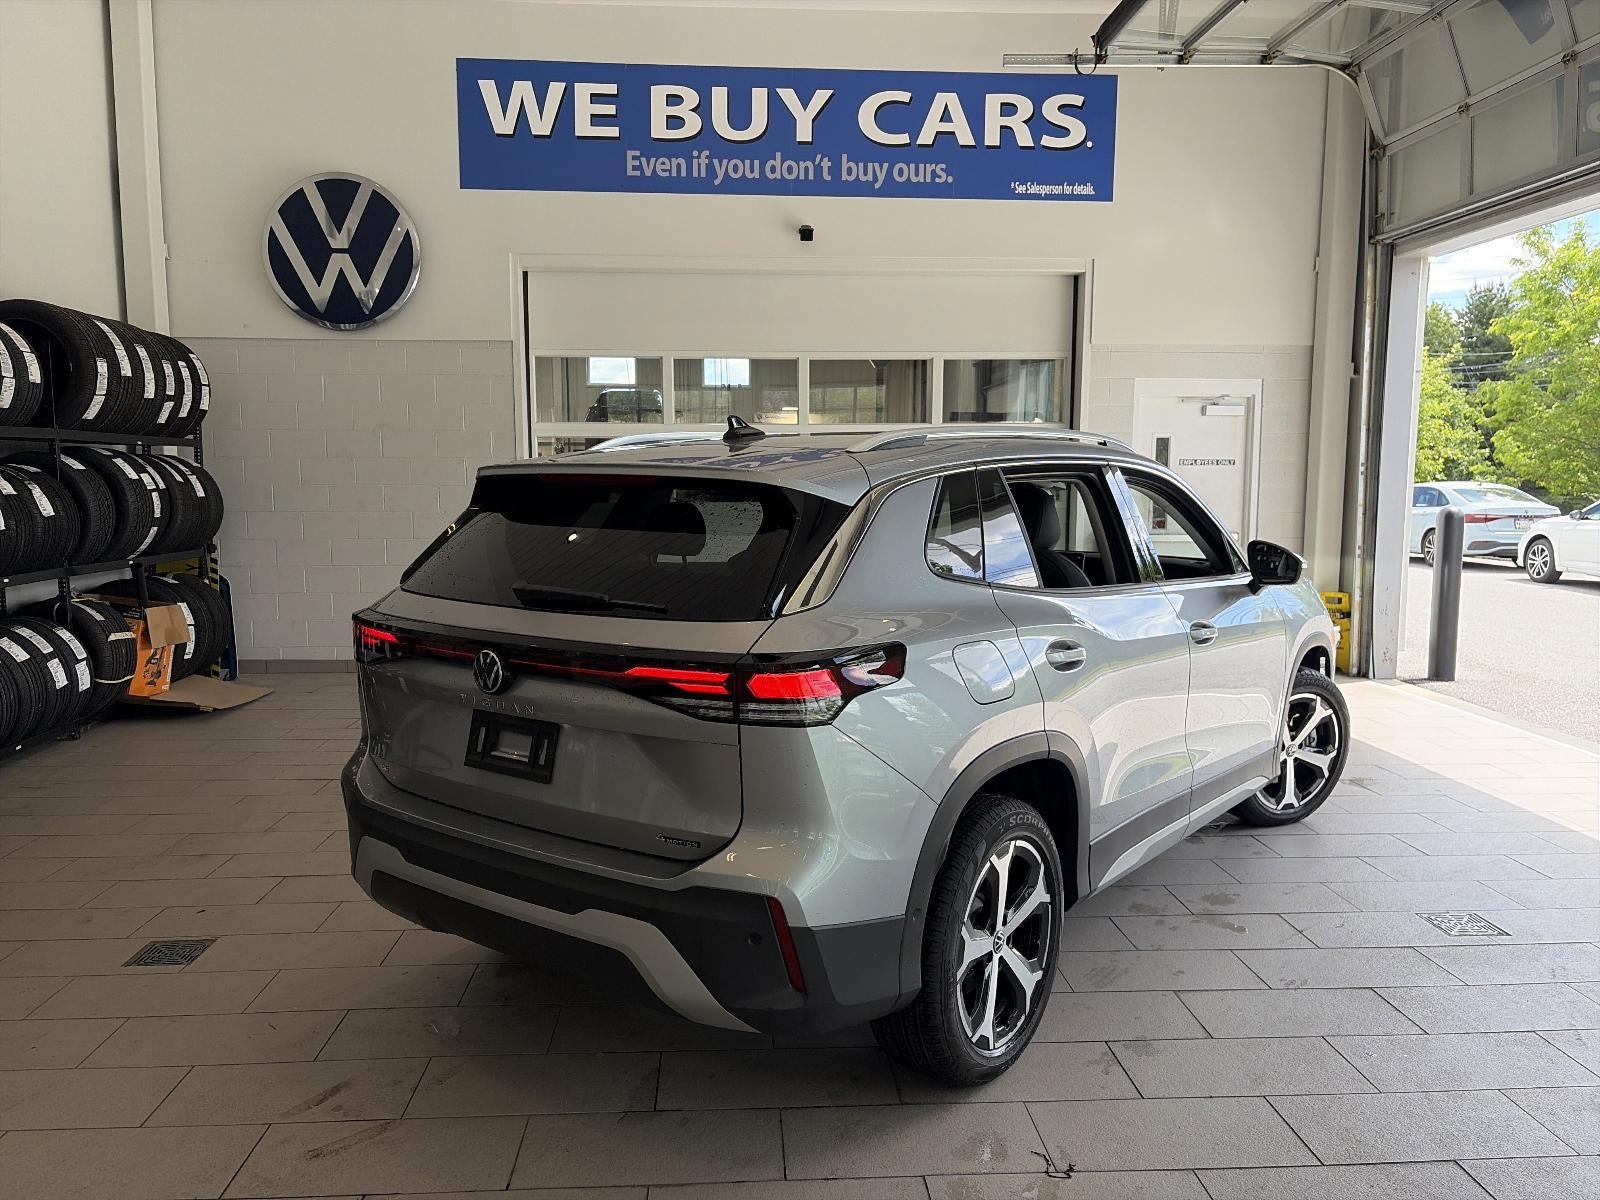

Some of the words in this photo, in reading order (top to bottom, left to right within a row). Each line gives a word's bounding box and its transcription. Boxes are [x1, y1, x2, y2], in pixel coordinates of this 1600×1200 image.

[476, 79, 621, 139] WE
[650, 84, 835, 143] BUY
[857, 90, 1094, 150] CARS.
[626, 150, 687, 178] Even
[692, 150, 710, 178] if
[713, 157, 760, 186] you
[764, 151, 832, 181] don't
[840, 153, 889, 190] buy
[892, 161, 954, 184] ours.
[1027, 182, 1063, 197] Salesperson
[1063, 182, 1072, 195] for
[1073, 182, 1096, 195] details.
[262, 172, 421, 331] VW
[460, 693, 535, 715] TIGUAN
